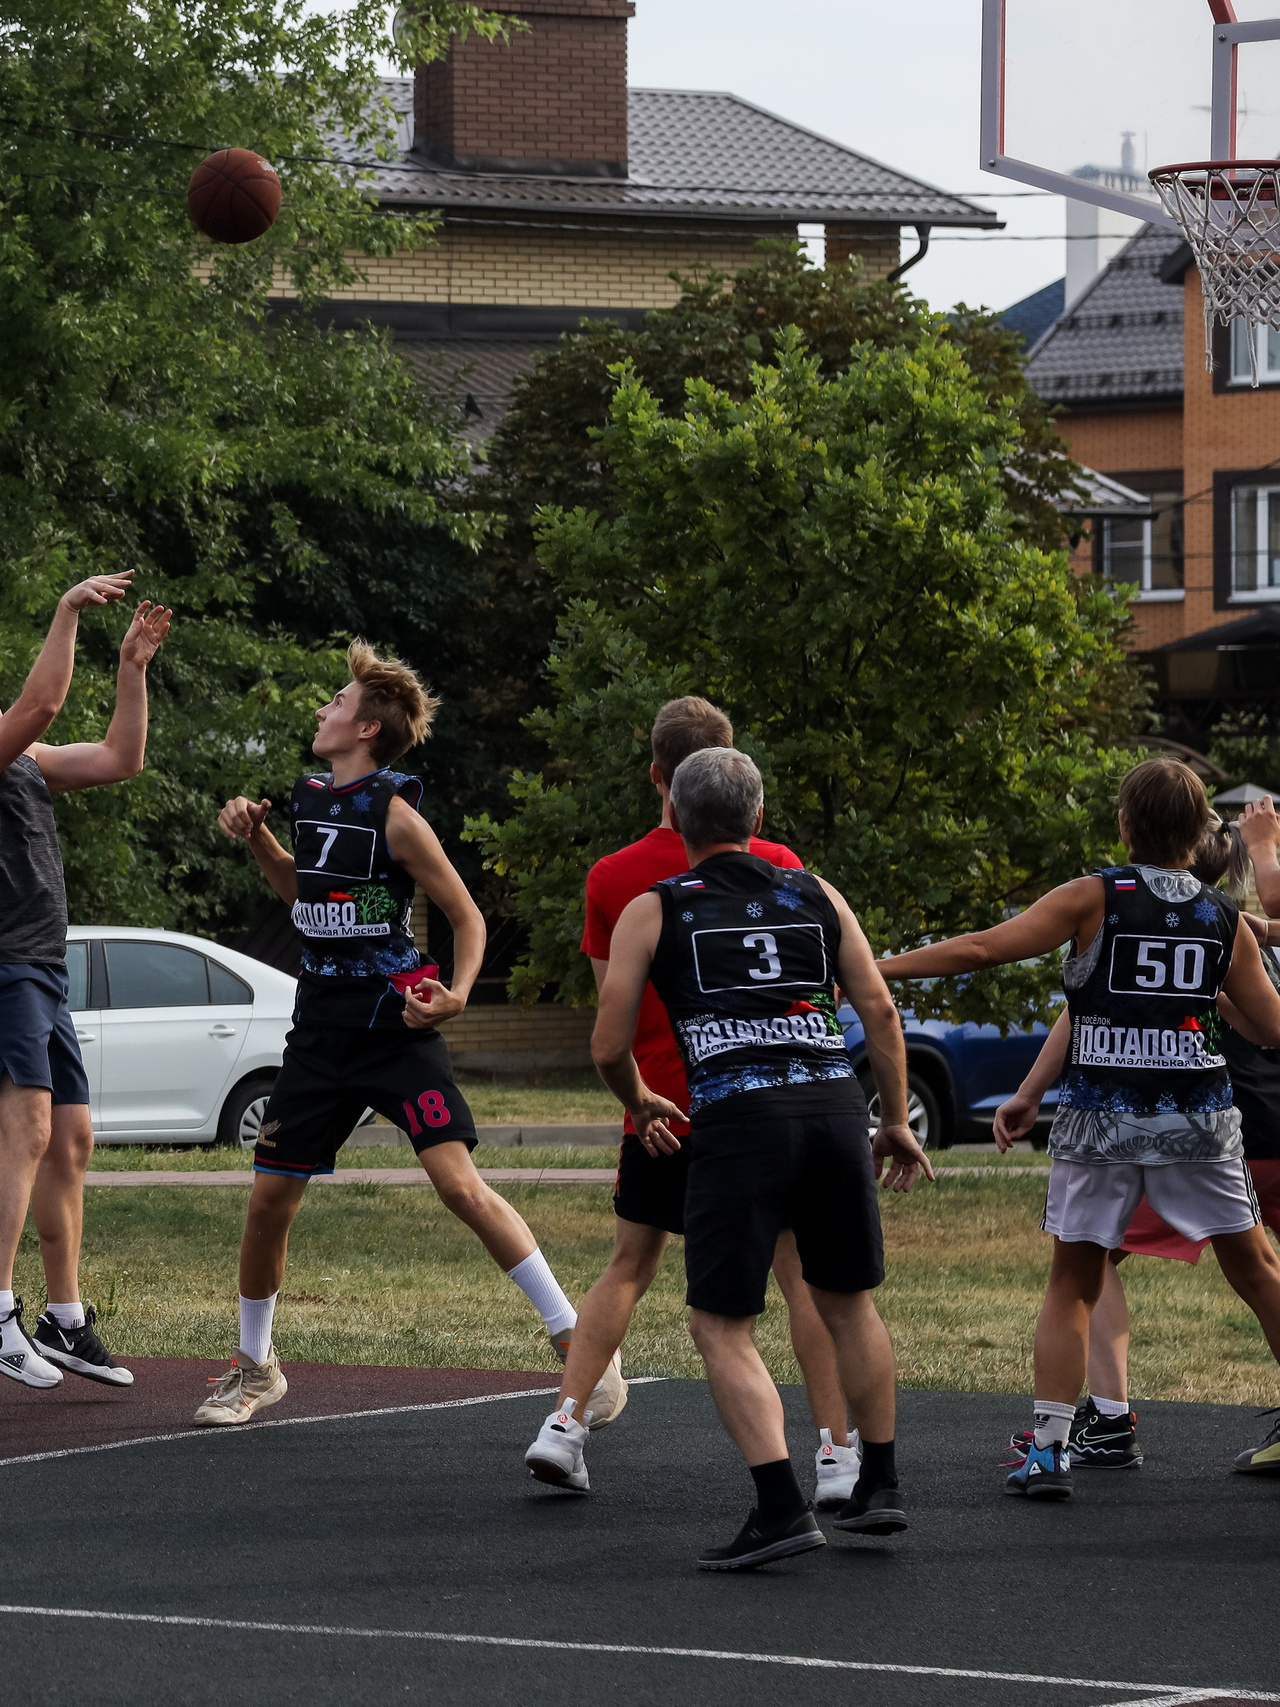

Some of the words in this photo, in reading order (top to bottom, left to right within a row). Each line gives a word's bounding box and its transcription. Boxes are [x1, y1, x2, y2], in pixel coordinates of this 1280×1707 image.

[314, 827, 339, 868] 7
[341, 926, 388, 936] Москва
[743, 933, 782, 980] 3
[1135, 941, 1205, 990] 50
[684, 1013, 715, 1026] посёлок
[686, 1011, 827, 1049] ПОТАПОВО
[1081, 1014, 1111, 1026] посёлок
[698, 1041, 728, 1058] Моя
[1080, 1024, 1207, 1058] ПОТАПОВО
[1082, 1053, 1111, 1065] Моя
[1114, 1056, 1191, 1068] маленькая
[403, 1089, 451, 1136] 18
